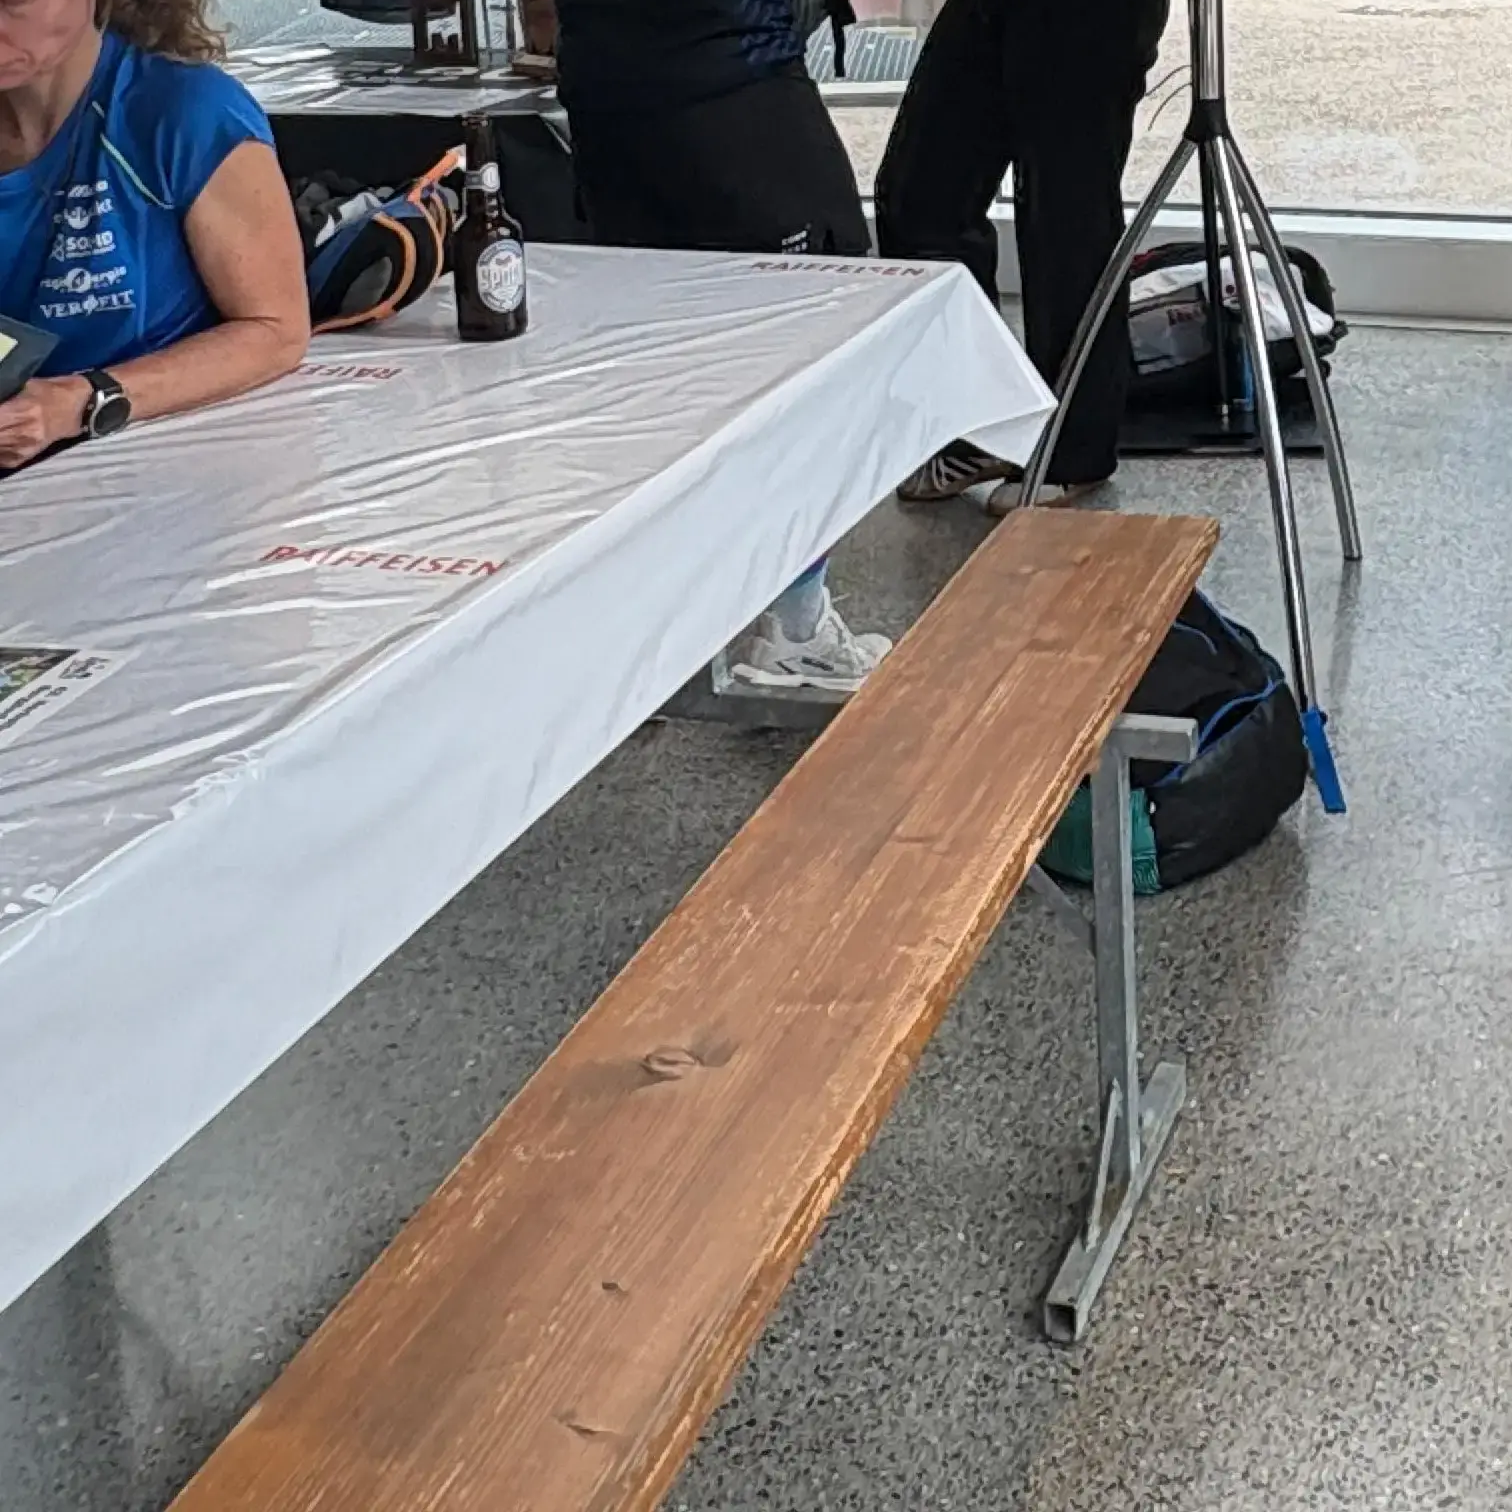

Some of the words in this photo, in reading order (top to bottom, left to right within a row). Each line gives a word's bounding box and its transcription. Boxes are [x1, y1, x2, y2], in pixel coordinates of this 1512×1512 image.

[751, 260, 925, 277] RAIFFEISEN
[297, 363, 403, 381] RAIFF
[259, 545, 508, 577] RAIFFEISEN
